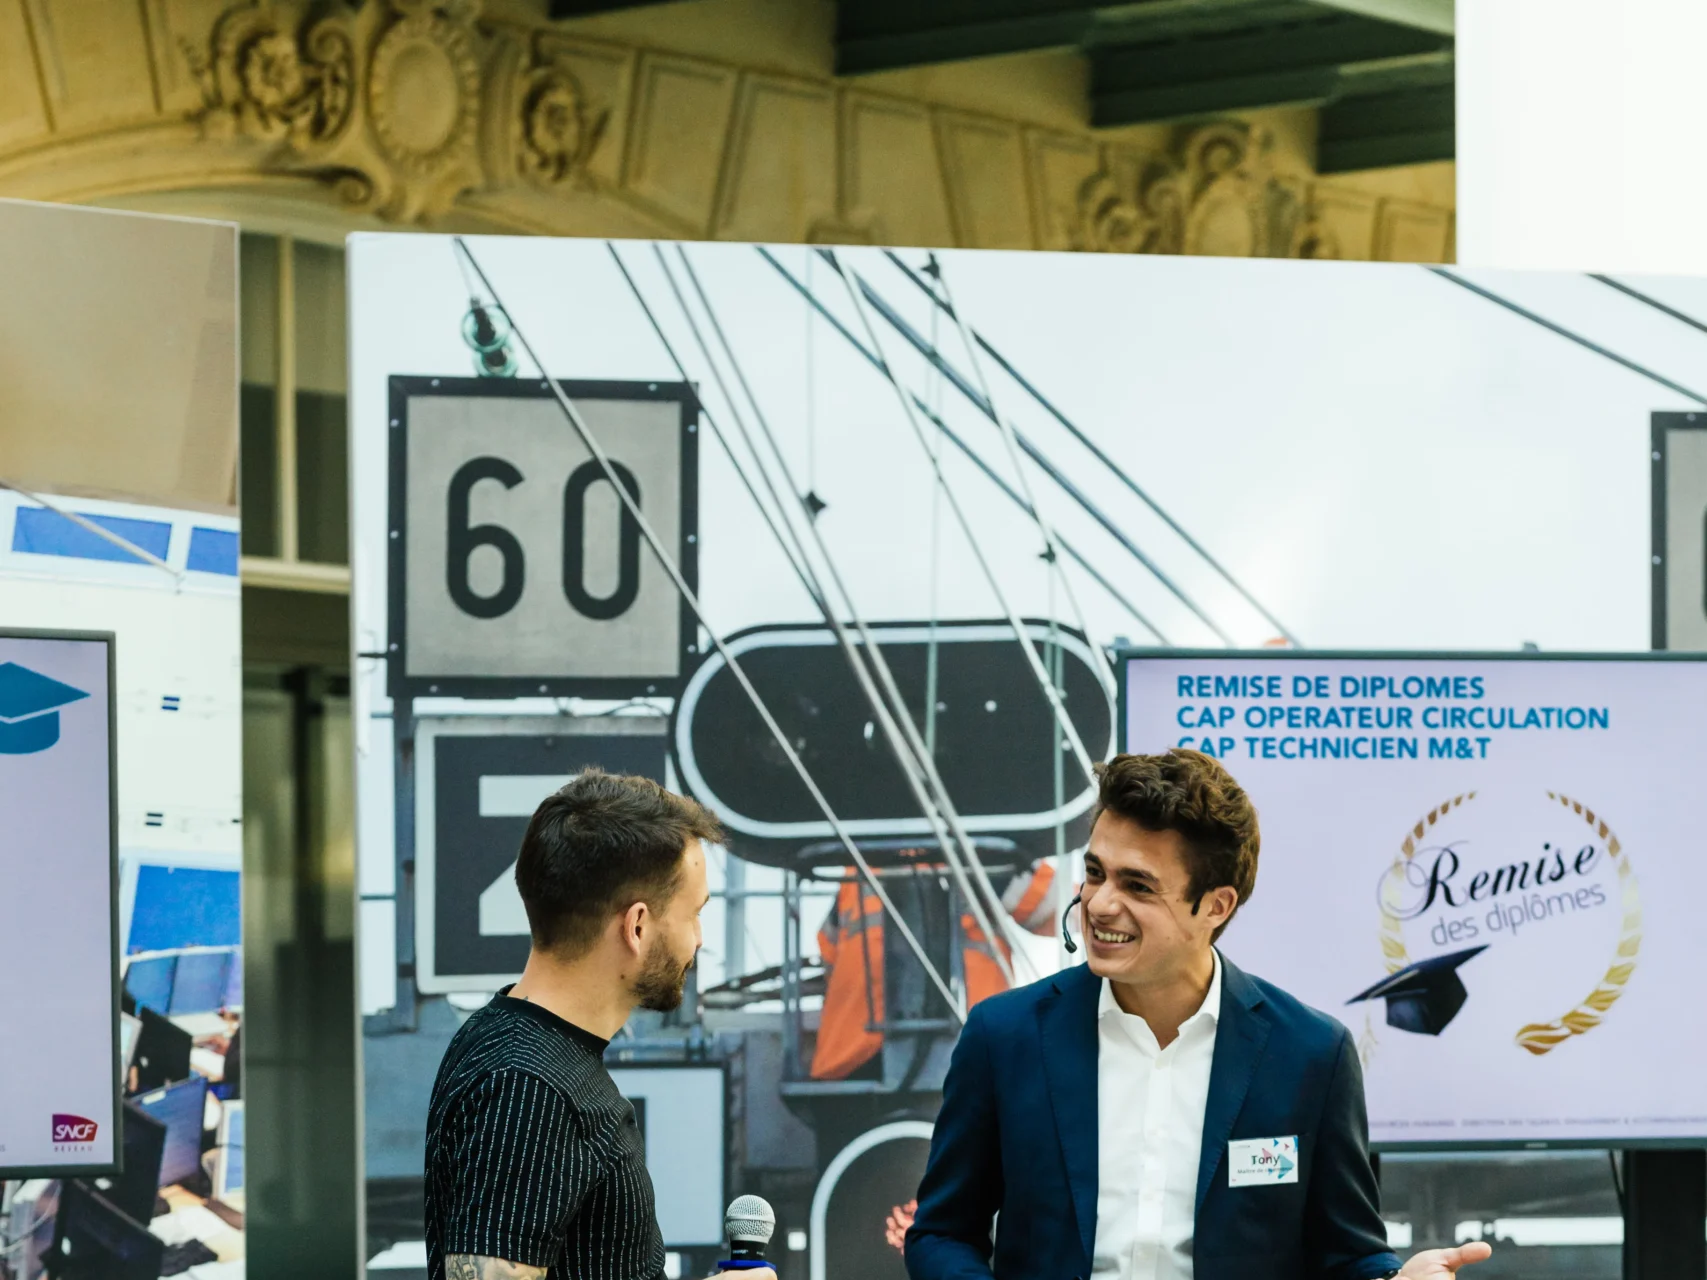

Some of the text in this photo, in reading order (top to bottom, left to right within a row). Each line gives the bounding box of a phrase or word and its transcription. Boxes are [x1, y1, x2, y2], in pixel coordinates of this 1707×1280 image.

[445, 455, 642, 620] 60
[1176, 675, 1485, 699] REMISE DE DIPLOMES
[1176, 706, 1609, 730] CAP OPERATEUR CIRCULATION
[1243, 737, 1419, 760] TECHNICIEN
[1428, 737, 1492, 760] M&T
[1377, 840, 1603, 922] Remise
[1430, 884, 1606, 947] des diplômes
[54, 1123, 95, 1140] SNCF
[1251, 1155, 1280, 1166] Tony
